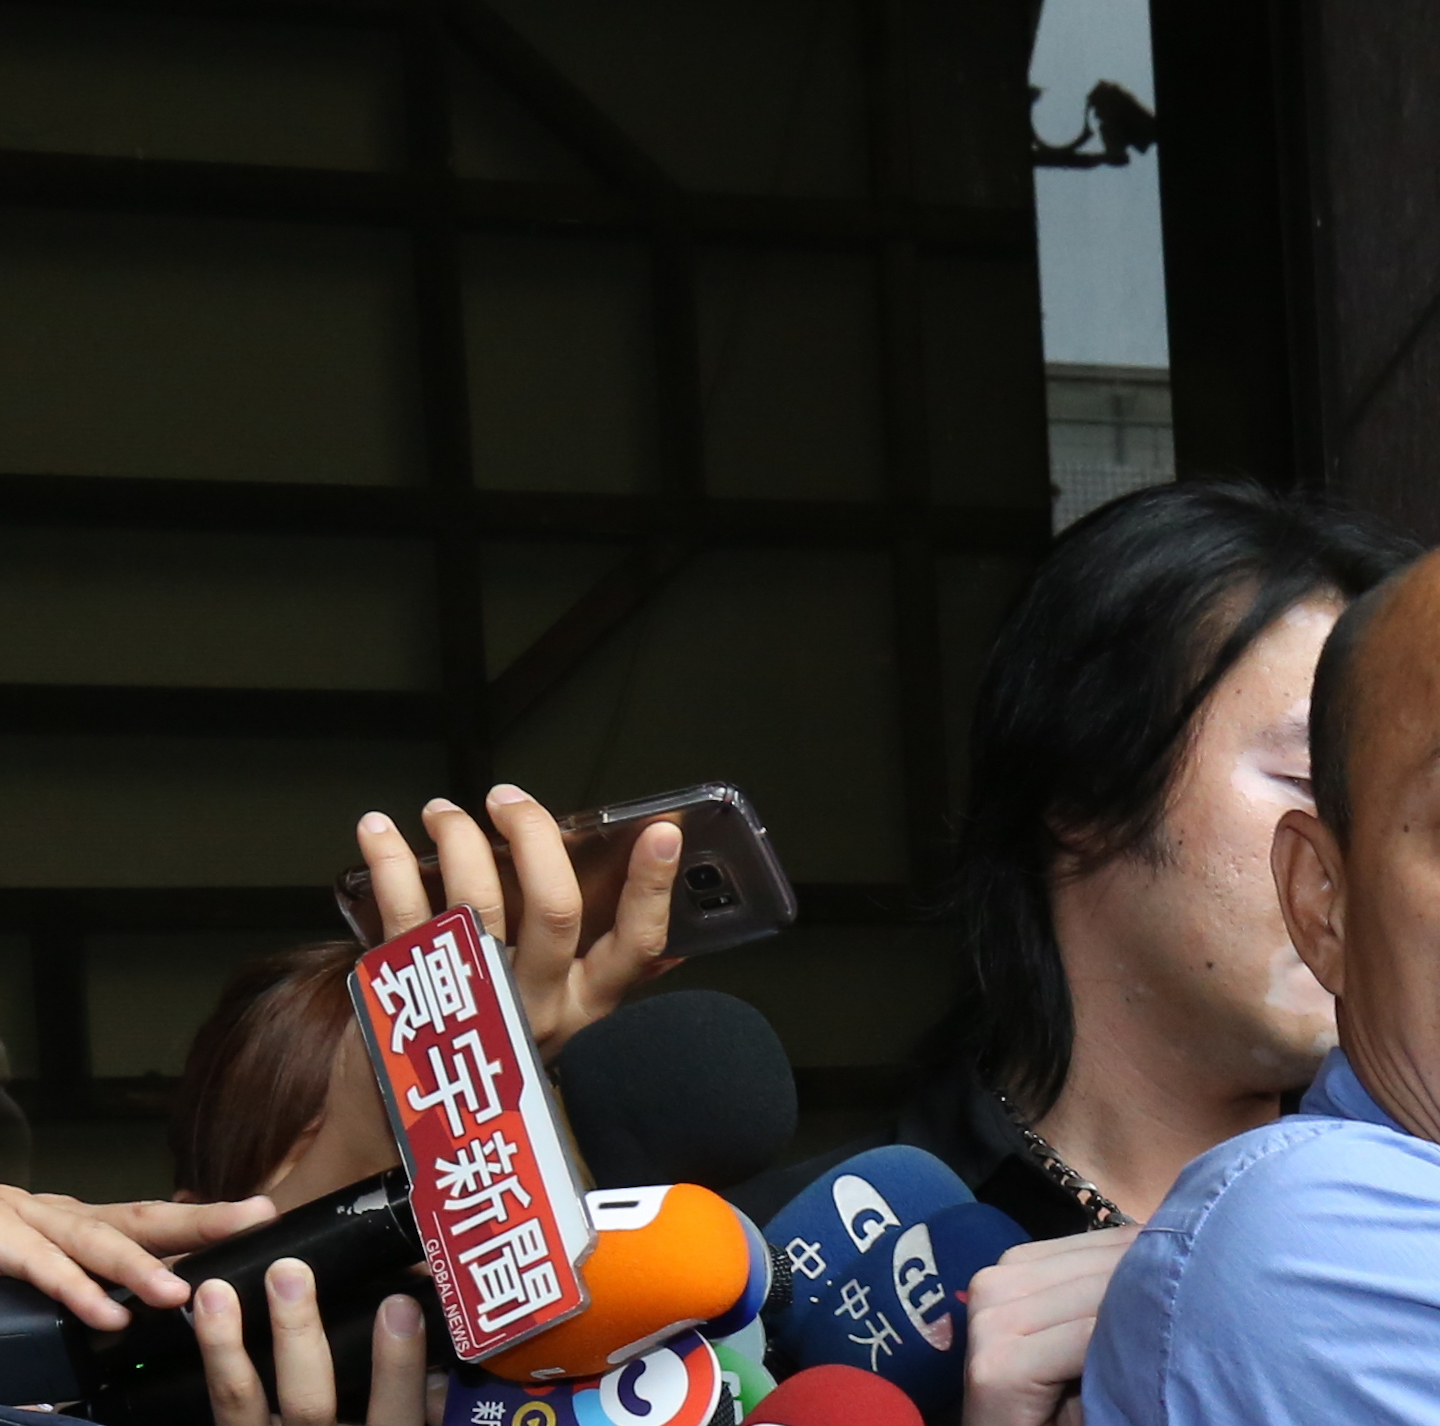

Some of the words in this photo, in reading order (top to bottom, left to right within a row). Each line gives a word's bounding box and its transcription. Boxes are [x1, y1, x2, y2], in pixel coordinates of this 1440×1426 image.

[370, 930, 562, 1333] 寰宇新聞
[426, 1237, 453, 1304] GLOBAL
[444, 1302, 471, 1355] NEWS
[834, 1278, 903, 1372] 中天
